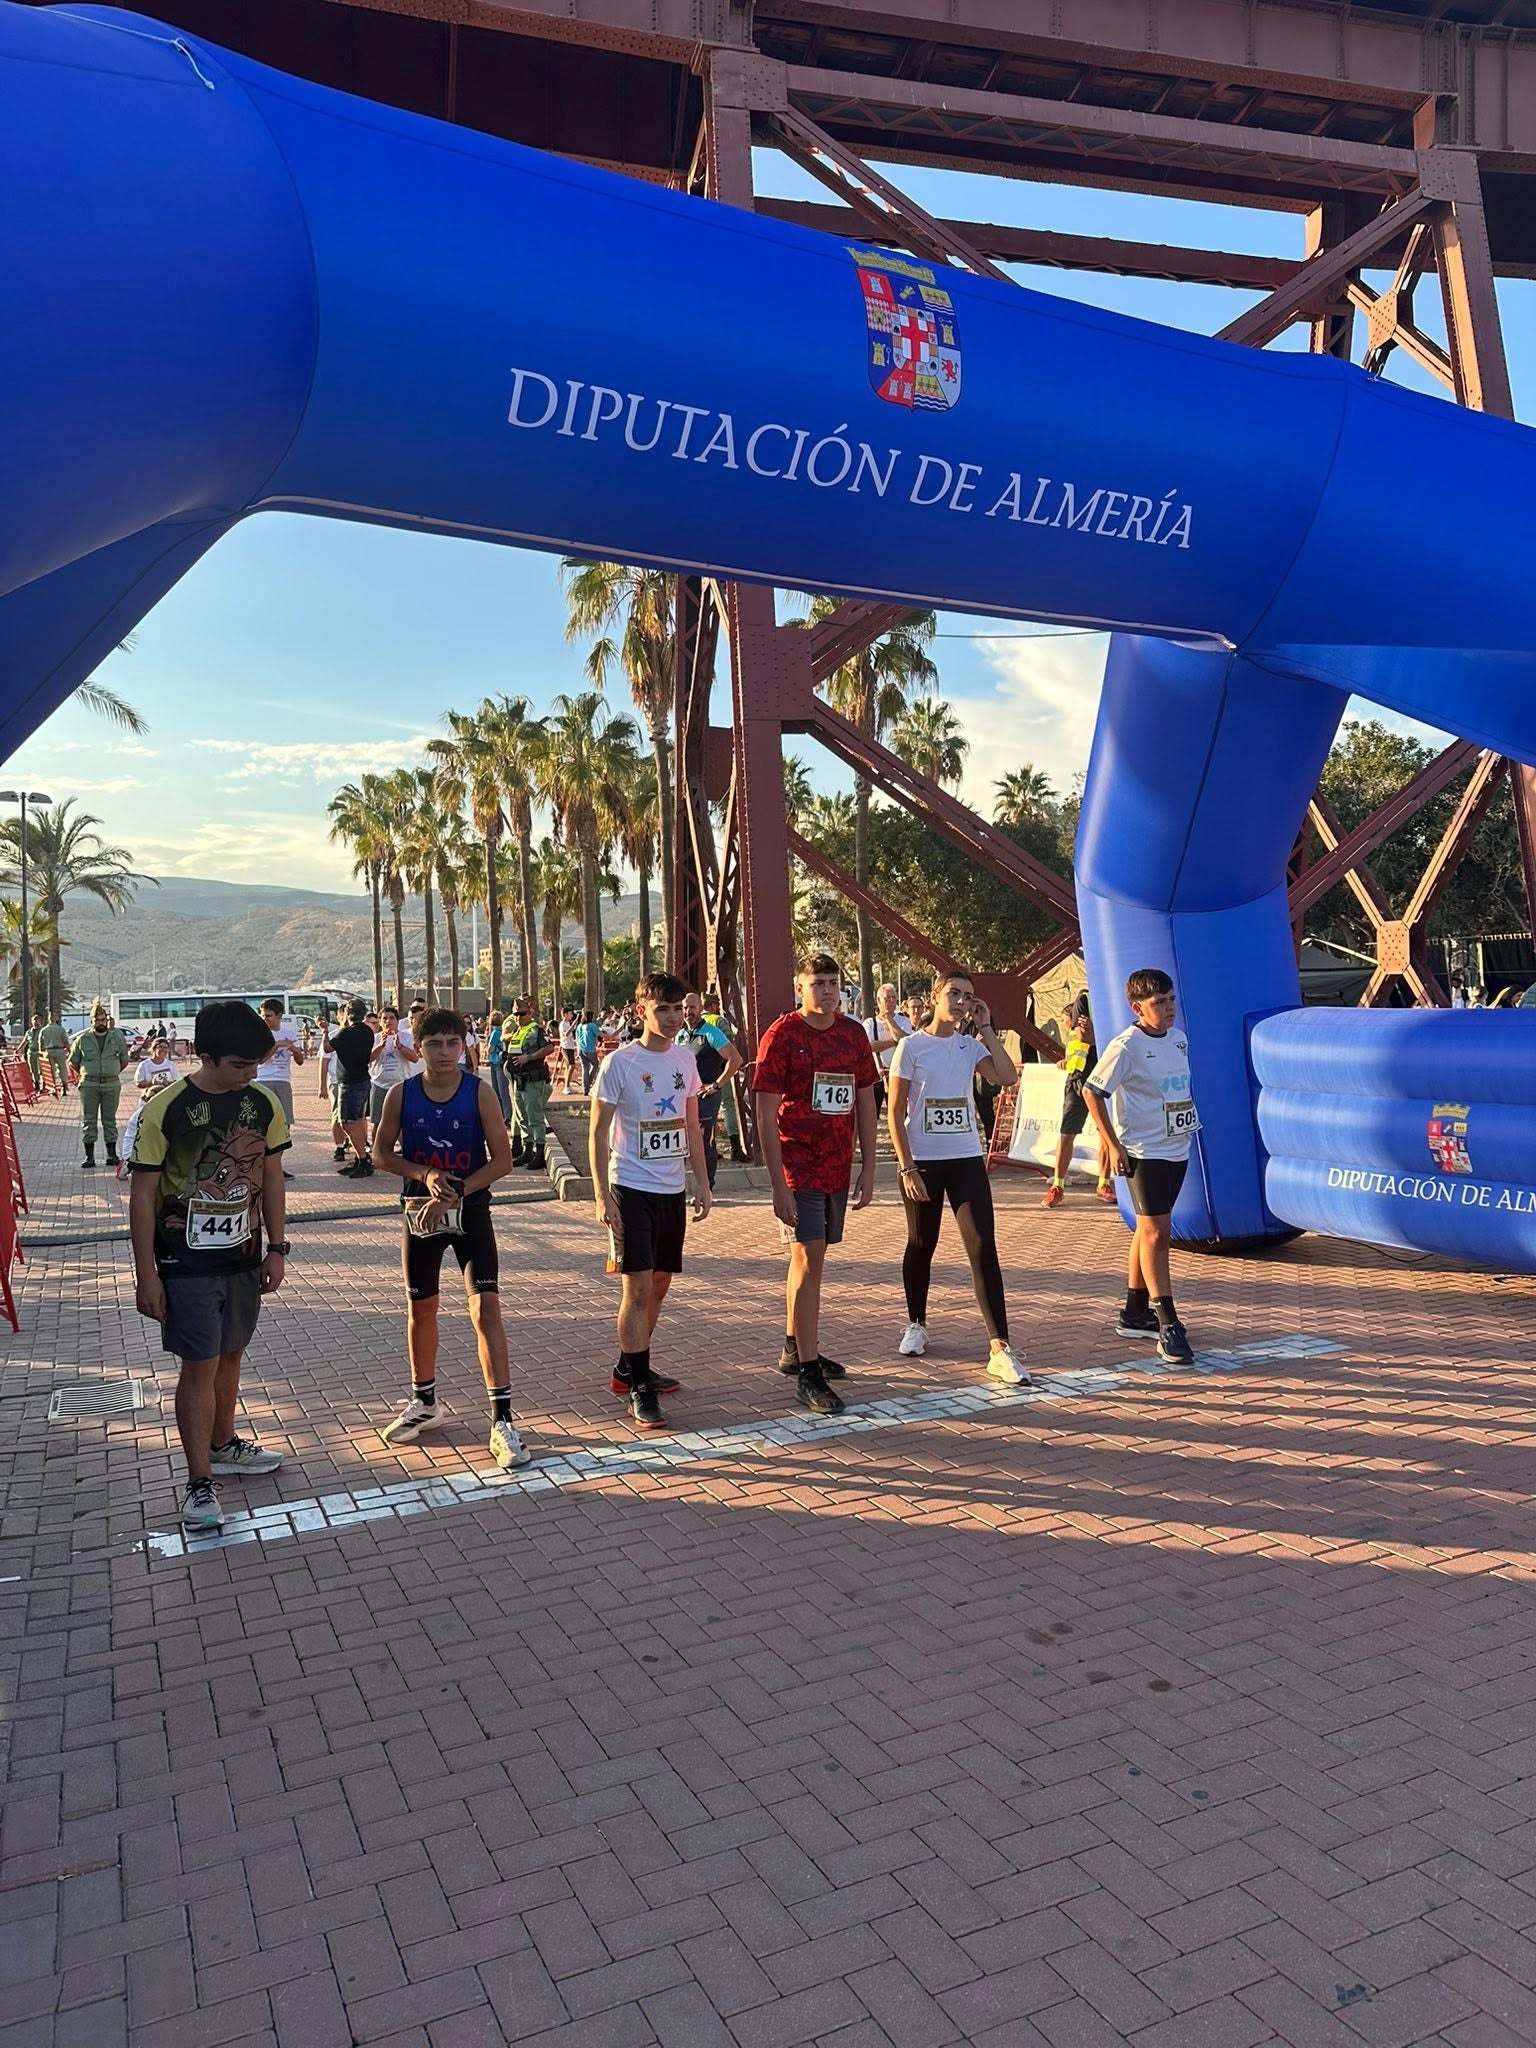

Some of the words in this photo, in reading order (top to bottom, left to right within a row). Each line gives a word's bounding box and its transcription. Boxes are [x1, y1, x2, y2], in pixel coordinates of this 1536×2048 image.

[507, 367, 903, 498] DIPUTACIÓN
[909, 454, 984, 512] DE
[984, 471, 1195, 550] ALMERÍA
[825, 1087, 849, 1104] 162
[934, 1109, 963, 1125] 335
[649, 1131, 680, 1150] 611
[1327, 1166, 1457, 1204] DIPUTACIÓN
[1460, 1184, 1493, 1208] DE
[201, 1214, 244, 1236] 441
